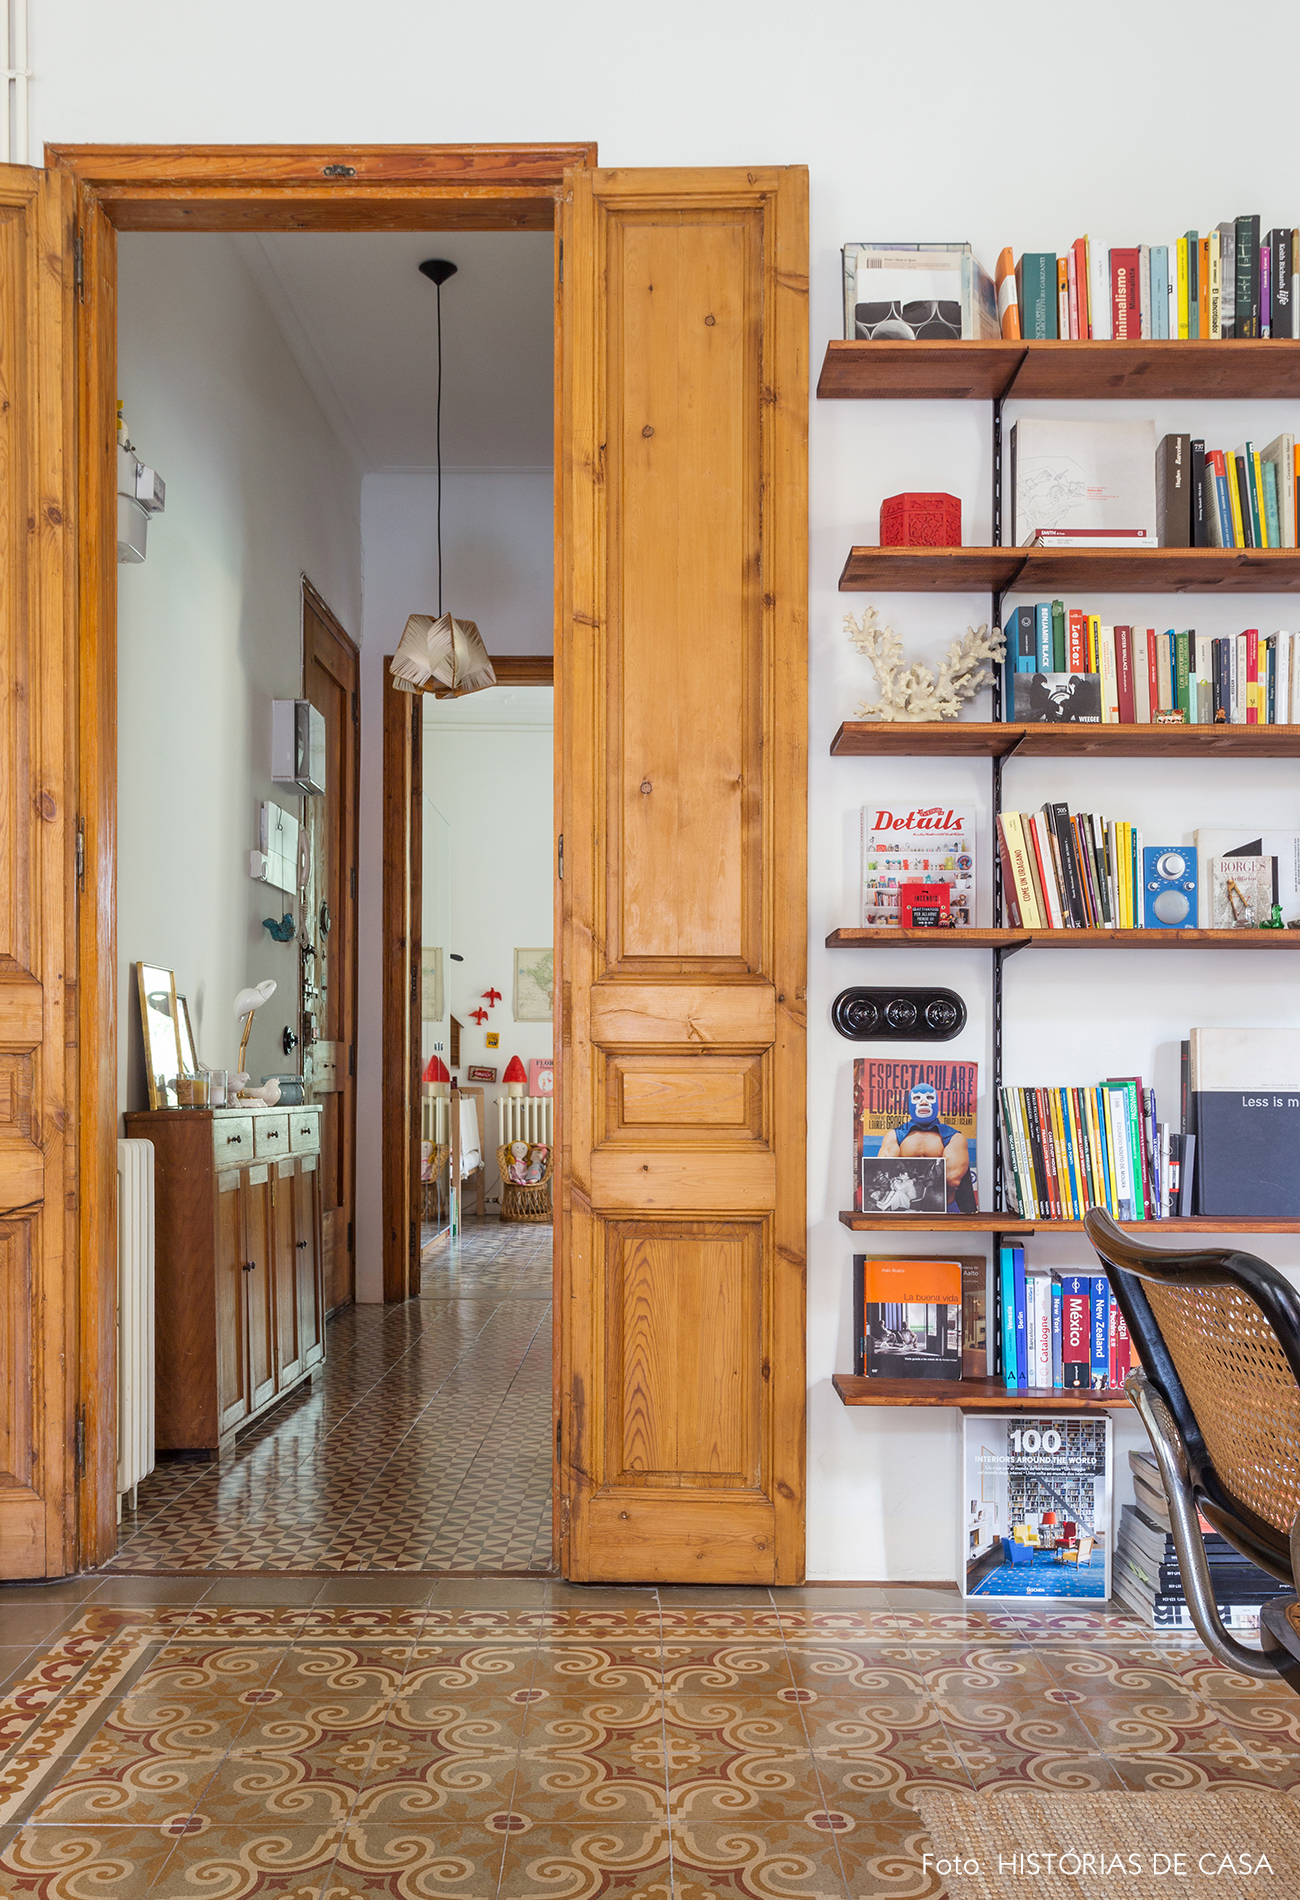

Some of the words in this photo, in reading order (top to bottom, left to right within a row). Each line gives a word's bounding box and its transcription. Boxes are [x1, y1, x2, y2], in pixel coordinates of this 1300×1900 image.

[1277, 290, 1289, 305] life
[1072, 624, 1080, 666] Lester
[871, 809, 965, 830] Details
[1014, 849, 1026, 875] URAGANO
[1220, 861, 1266, 872] BORGES
[1020, 876, 1027, 886] UN
[1022, 887, 1031, 902] COME
[869, 1063, 965, 1092] ESPECTACULAR
[869, 1090, 910, 1115] LUCHA
[940, 1091, 973, 1117] LIBRE
[1025, 1092, 1034, 1119] CARAVAGGIO
[1128, 1084, 1137, 1120] PASSIVHAUS
[1242, 1096, 1268, 1107] Less
[1273, 1096, 1283, 1107] is
[869, 1120, 885, 1129] LOURDES
[886, 1116, 909, 1130] GROBET
[1095, 1299, 1104, 1320] New
[1070, 1298, 1082, 1347] México
[1040, 1316, 1049, 1363] Catalogne
[1095, 1321, 1104, 1358] Zealand
[1010, 1429, 1061, 1453] 100
